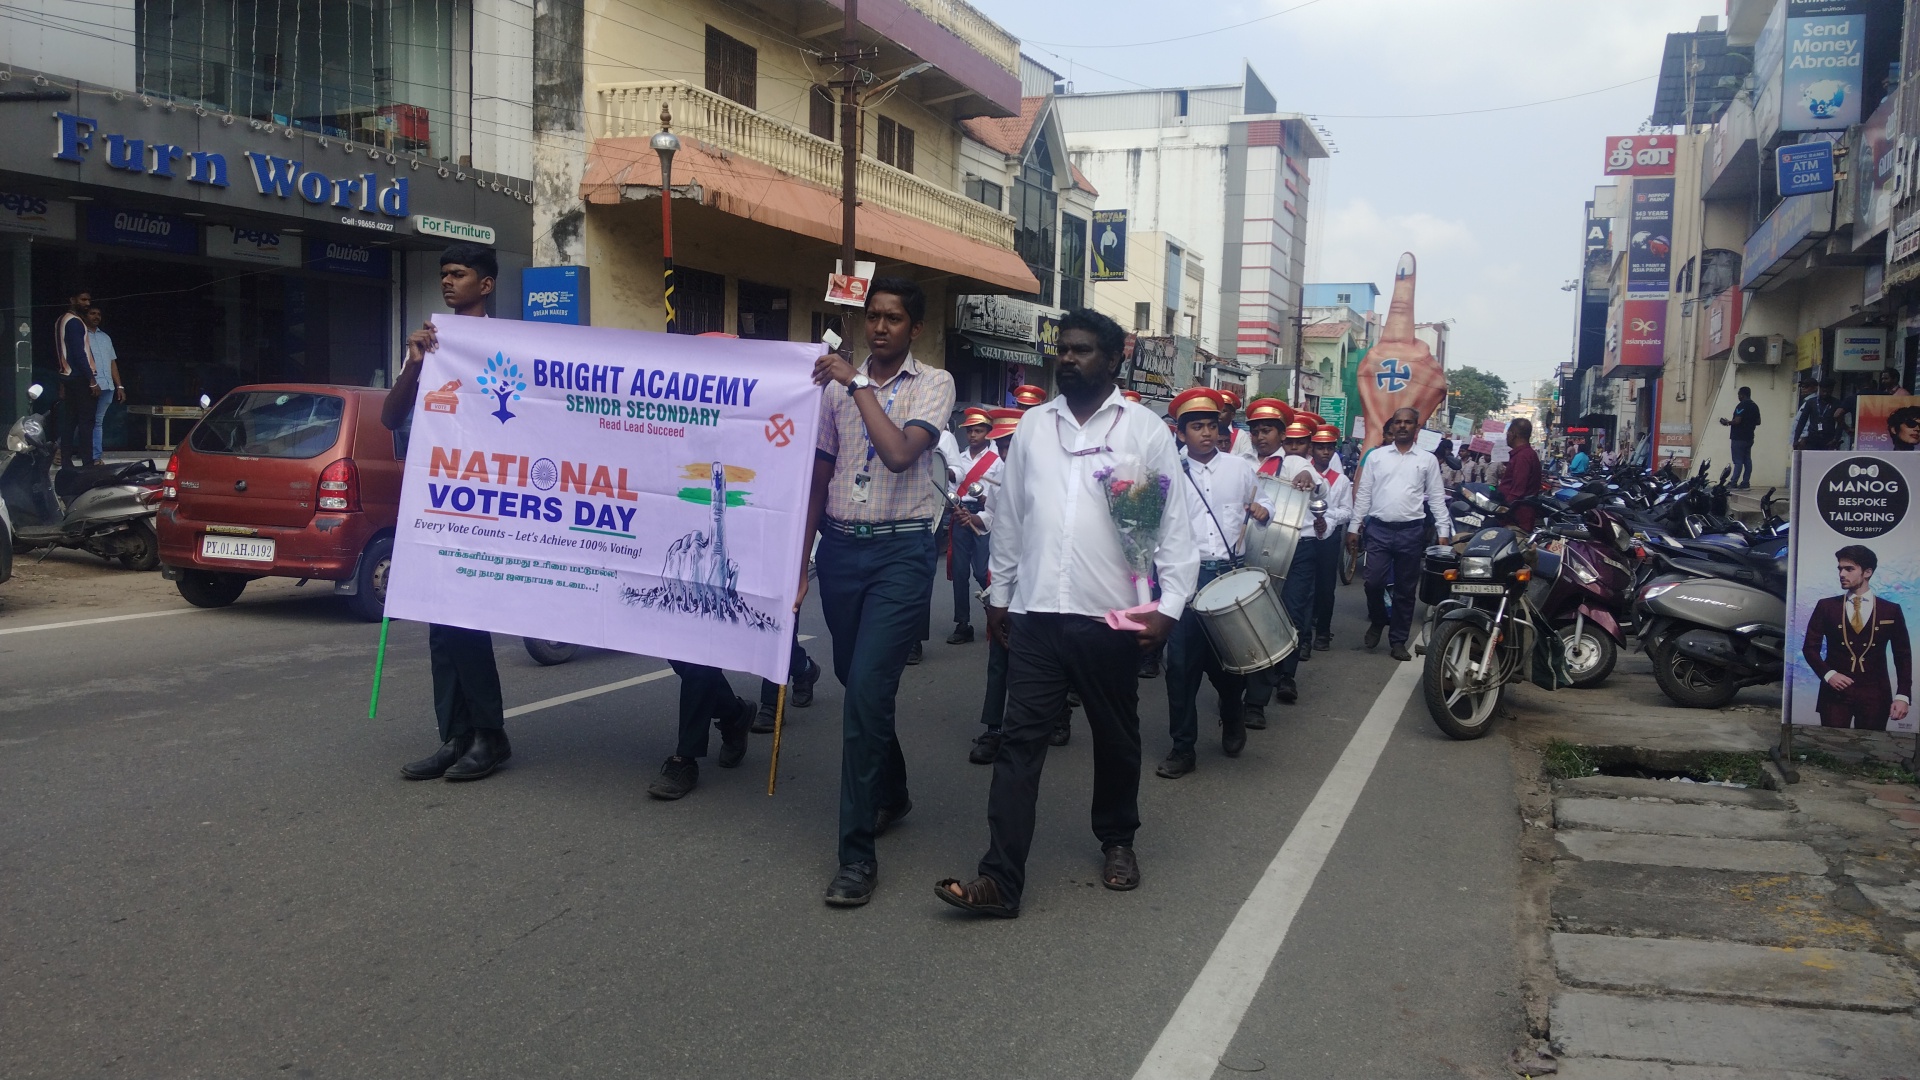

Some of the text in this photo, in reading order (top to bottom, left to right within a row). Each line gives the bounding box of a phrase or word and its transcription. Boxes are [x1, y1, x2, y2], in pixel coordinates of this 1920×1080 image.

[1802, 21, 1850, 37] Send
[1792, 38, 1858, 55] Money
[1788, 52, 1861, 70] Abroad
[52, 111, 410, 217] Furn World
[1606, 137, 1675, 173] தீன்
[1792, 160, 1819, 172] ATM
[1792, 172, 1820, 184] CDM
[0, 193, 48, 216] eps
[114, 212, 171, 236] பெப்ஸ்
[376, 222, 394, 232] 42727
[422, 216, 492, 240] For Furniture
[233, 228, 281, 248] peps
[326, 242, 370, 263] பெப்ஸ்
[528, 291, 560, 307] peps
[533, 309, 549, 317] DREAM
[980, 346, 1037, 366] CHAI MASTHAN
[533, 359, 760, 407] BRIGHT ACADEMY
[566, 394, 721, 427] SENIOR SECONDARY
[599, 417, 685, 438] Read Lead Succeed
[1829, 480, 1899, 493] MANOG
[428, 483, 637, 533] VOTERS DAY
[1838, 497, 1888, 507] BESPOKE
[1828, 511, 1895, 522] TAILORING
[414, 518, 446, 534] Every
[447, 522, 470, 534] Vote
[471, 525, 506, 539] Counts
[540, 534, 578, 548] Achieve
[579, 538, 608, 553] 100%
[610, 542, 643, 560] Voting!
[438, 548, 618, 580] வாக்களிப்பது நமது உரிமை மட்டுமல்ல!
[456, 566, 477, 577] அது
[478, 569, 504, 581] நமது
[505, 573, 554, 585] ஜனநாயக
[1676, 595, 1727, 606] Jupiter
